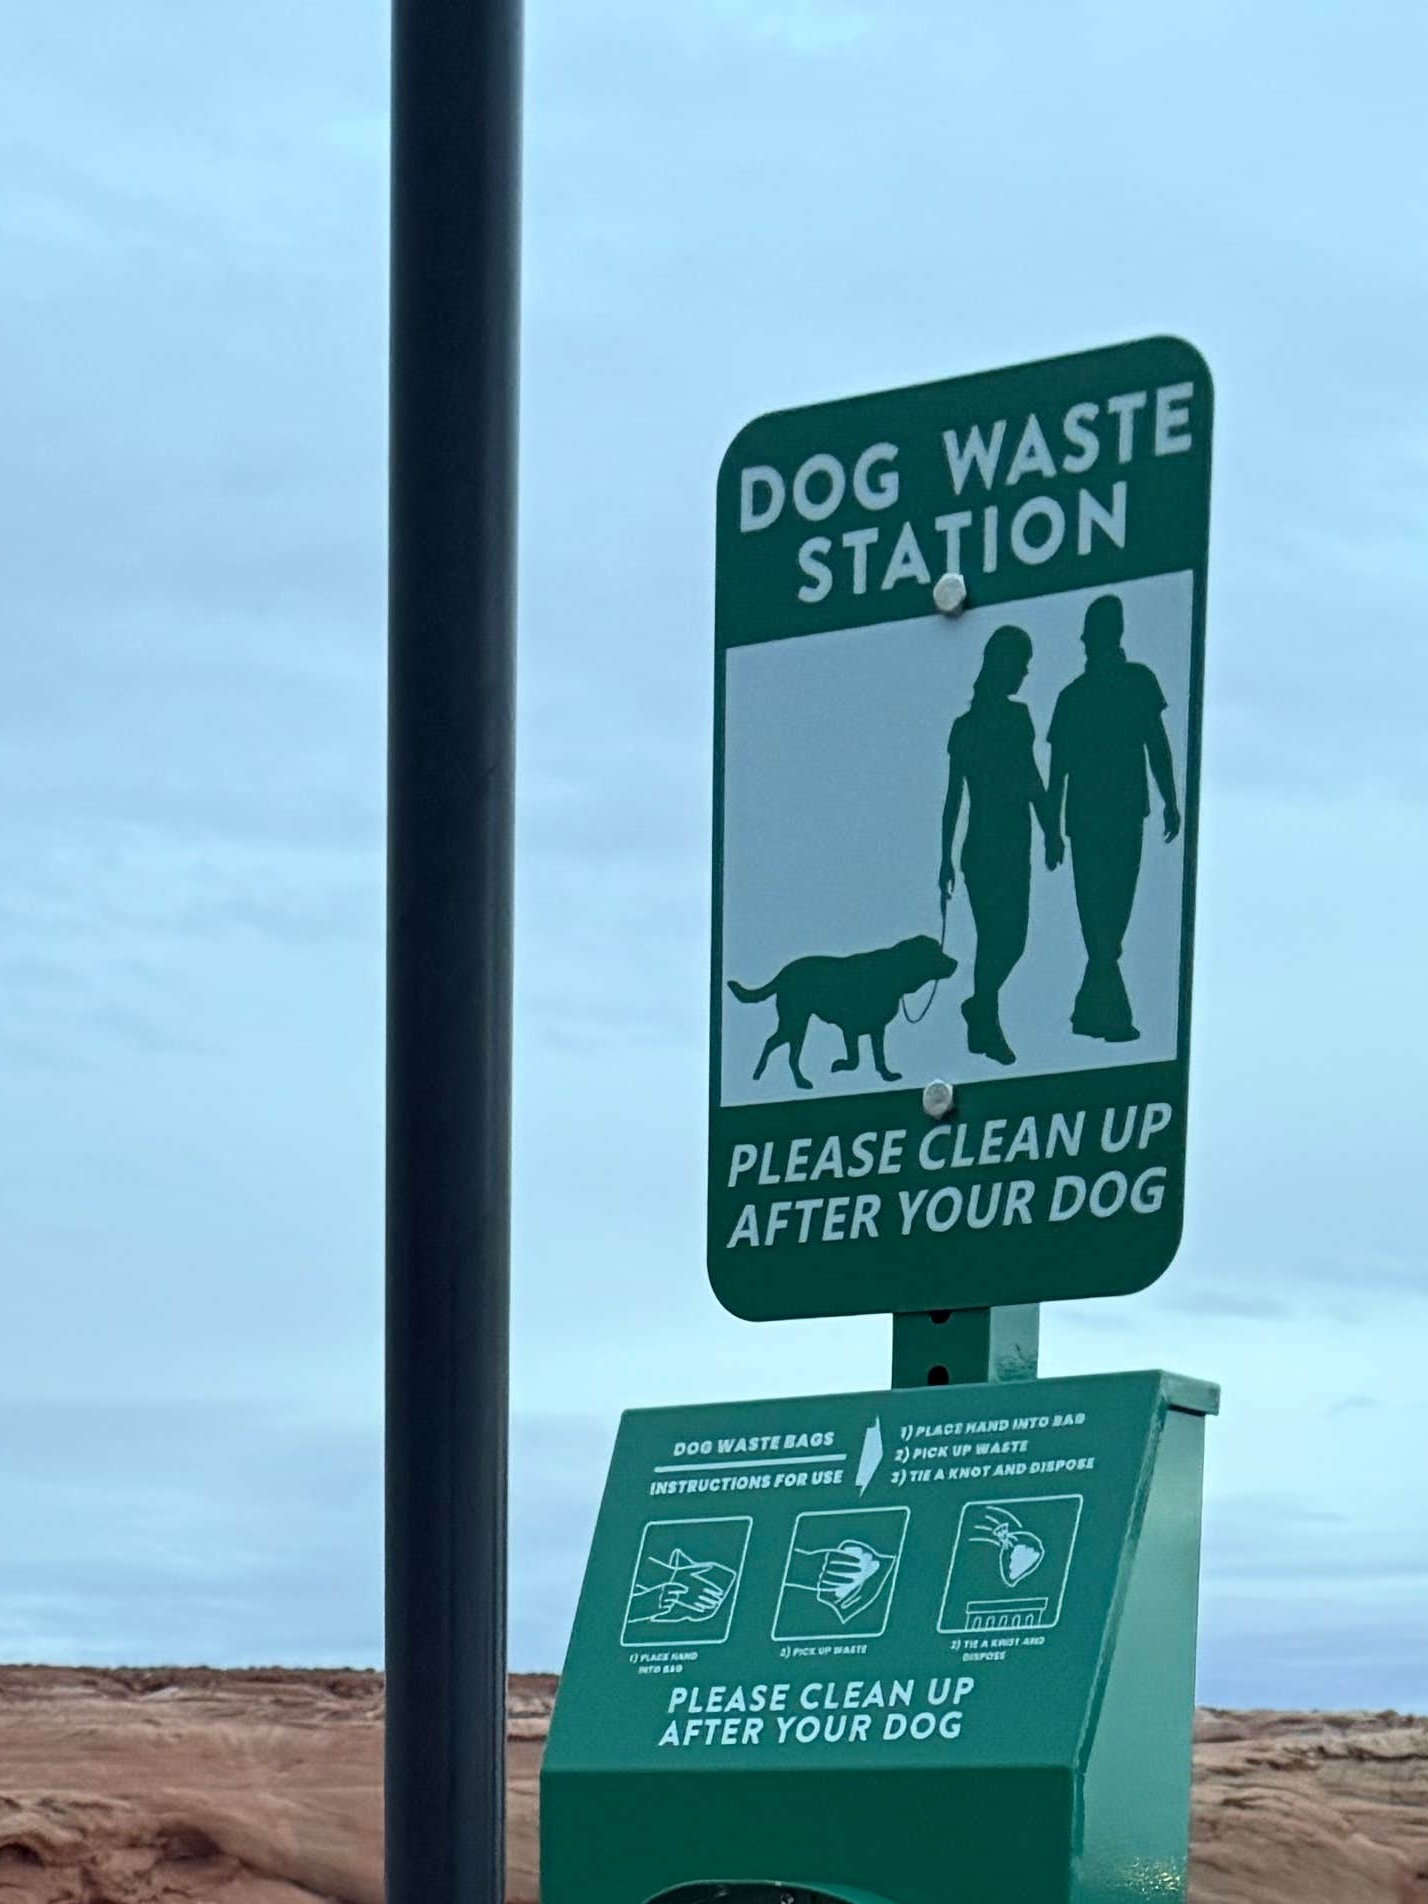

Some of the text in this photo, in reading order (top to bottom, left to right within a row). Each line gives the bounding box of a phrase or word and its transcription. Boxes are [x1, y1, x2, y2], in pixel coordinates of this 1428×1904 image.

[740, 381, 1193, 532] DOG WASTE
[798, 482, 1127, 603] STATION
[728, 1102, 1172, 1187] PLEASE CLEAN UP
[726, 1167, 1167, 1248] AFTER YOUR DOG
[900, 1413, 1086, 1441] 1) PLACE HAND INTO BAG
[673, 1432, 835, 1456] DOG WASTE BAGS
[894, 1440, 1028, 1463] 2) PICK UP WASTE
[650, 1470, 844, 1495] INSTRUCTIONS FOR USE
[891, 1457, 1095, 1487] 3) TIE A KNOT AND DISPOSE
[793, 1646, 816, 1657] PICK
[818, 1646, 832, 1656] UP
[833, 1644, 868, 1655] WASTE
[980, 1639, 989, 1648] A
[667, 1676, 975, 1714] PLEASE CLEAN UP
[657, 1711, 964, 1746] AFTER YOUR DOG
